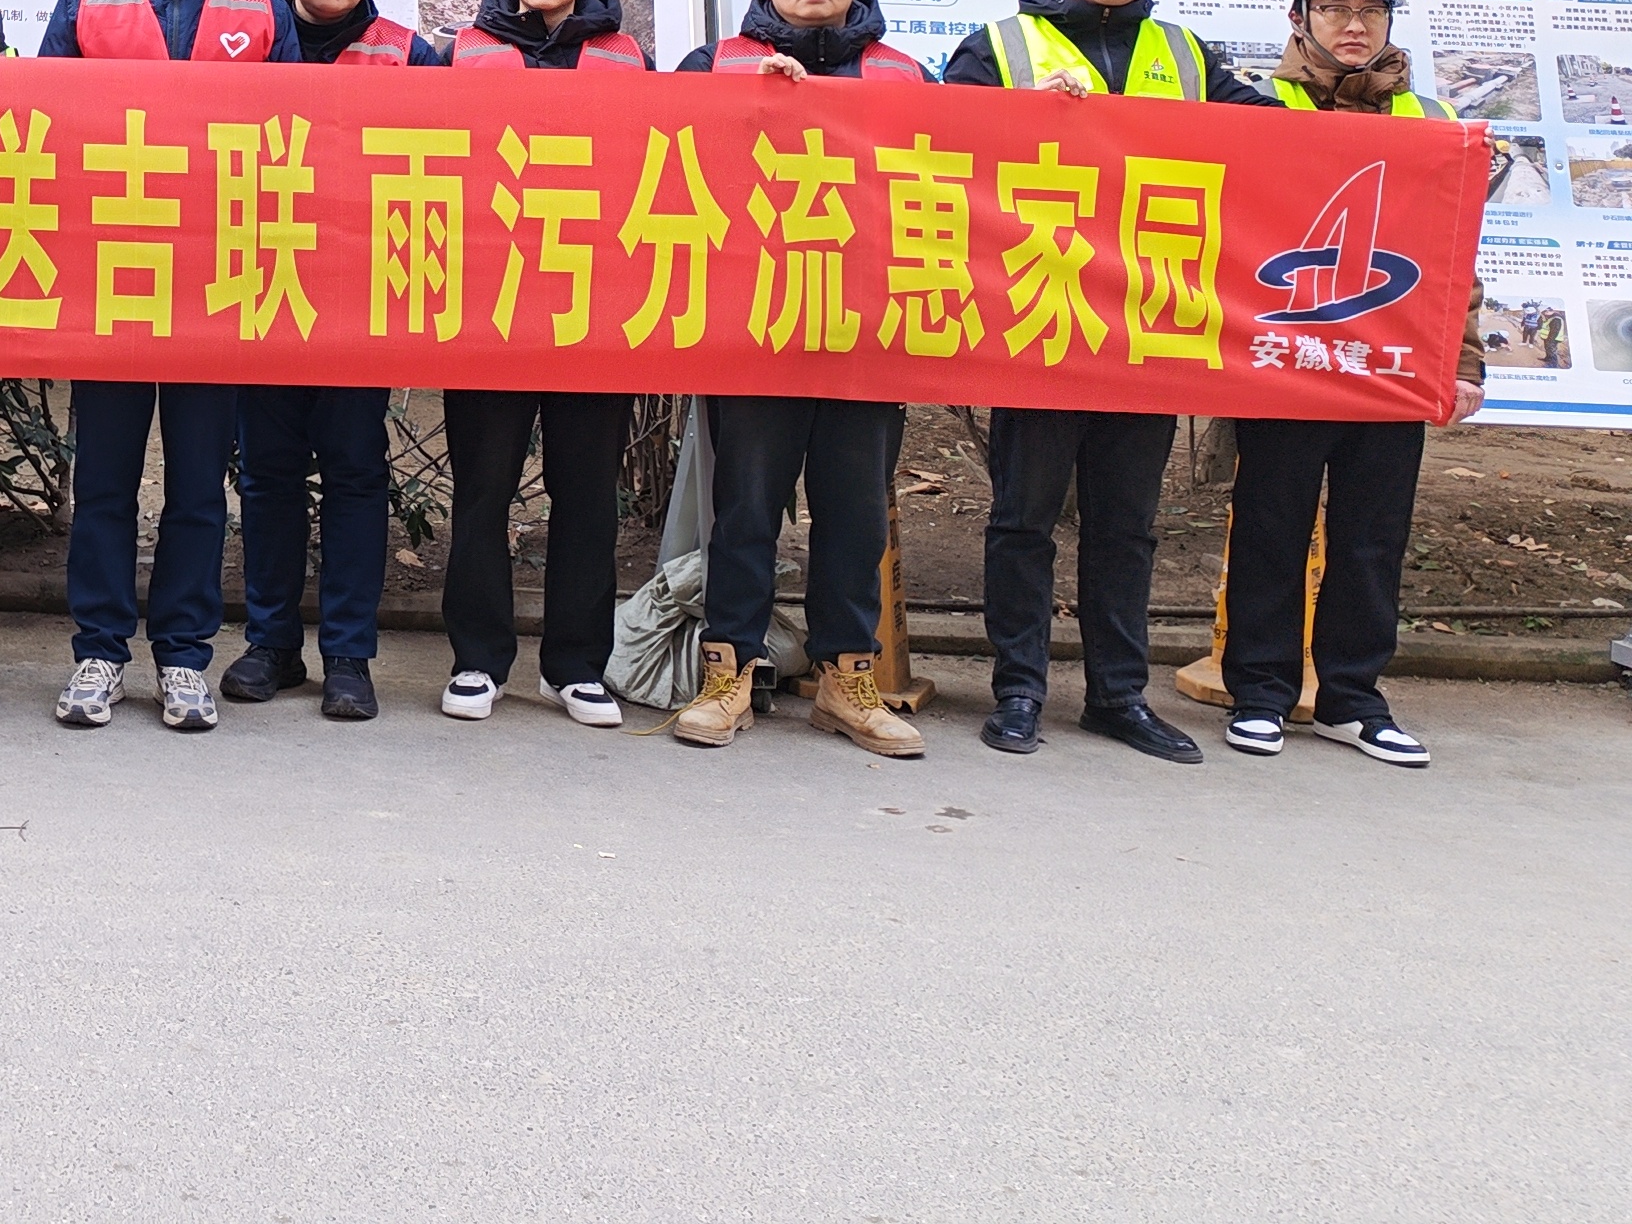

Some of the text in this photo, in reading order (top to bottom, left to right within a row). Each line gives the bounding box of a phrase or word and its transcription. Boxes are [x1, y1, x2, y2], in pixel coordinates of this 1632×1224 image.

[360, 126, 1227, 371] 雨污分流惠家园
[1249, 331, 1418, 380] 安徽建工
